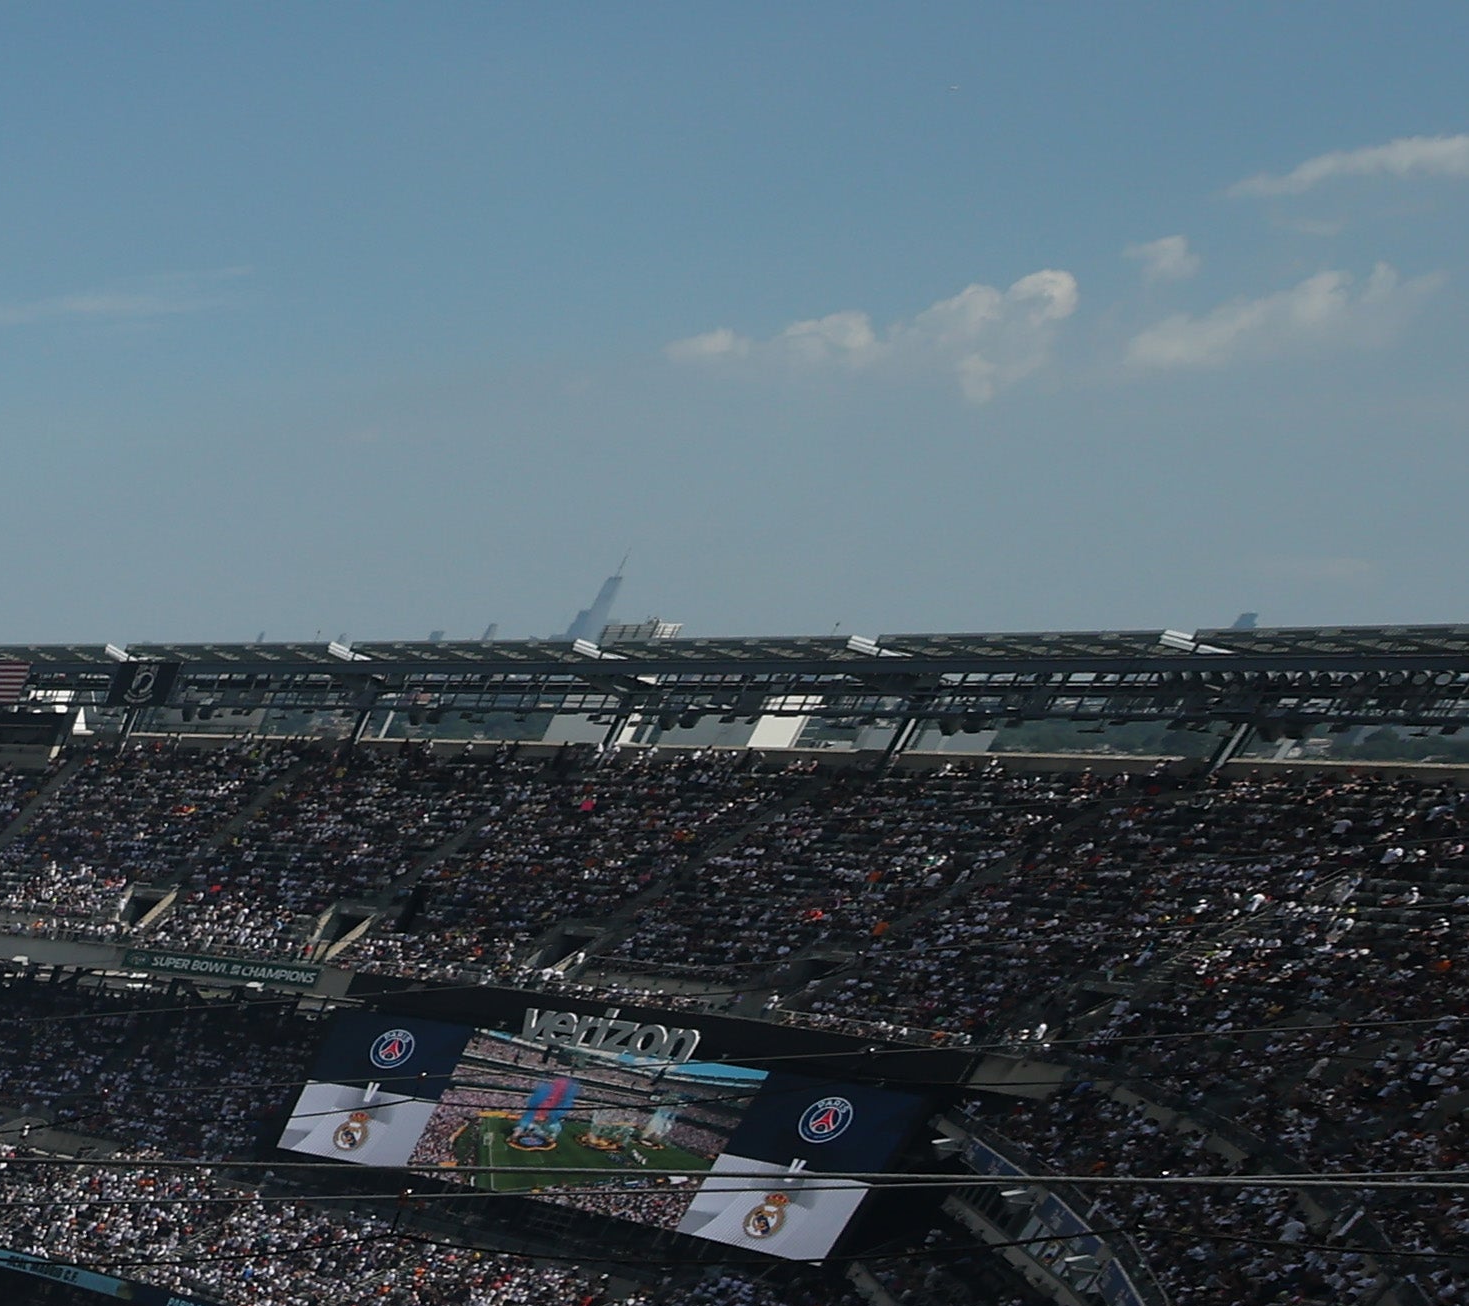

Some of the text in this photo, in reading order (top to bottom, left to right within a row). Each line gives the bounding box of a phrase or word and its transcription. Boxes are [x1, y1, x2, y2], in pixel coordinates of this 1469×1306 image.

[151, 956, 190, 970] SUPER
[191, 960, 228, 974] BOWL
[241, 968, 318, 984] CHAMPIONS
[522, 1009, 701, 1062] verizon
